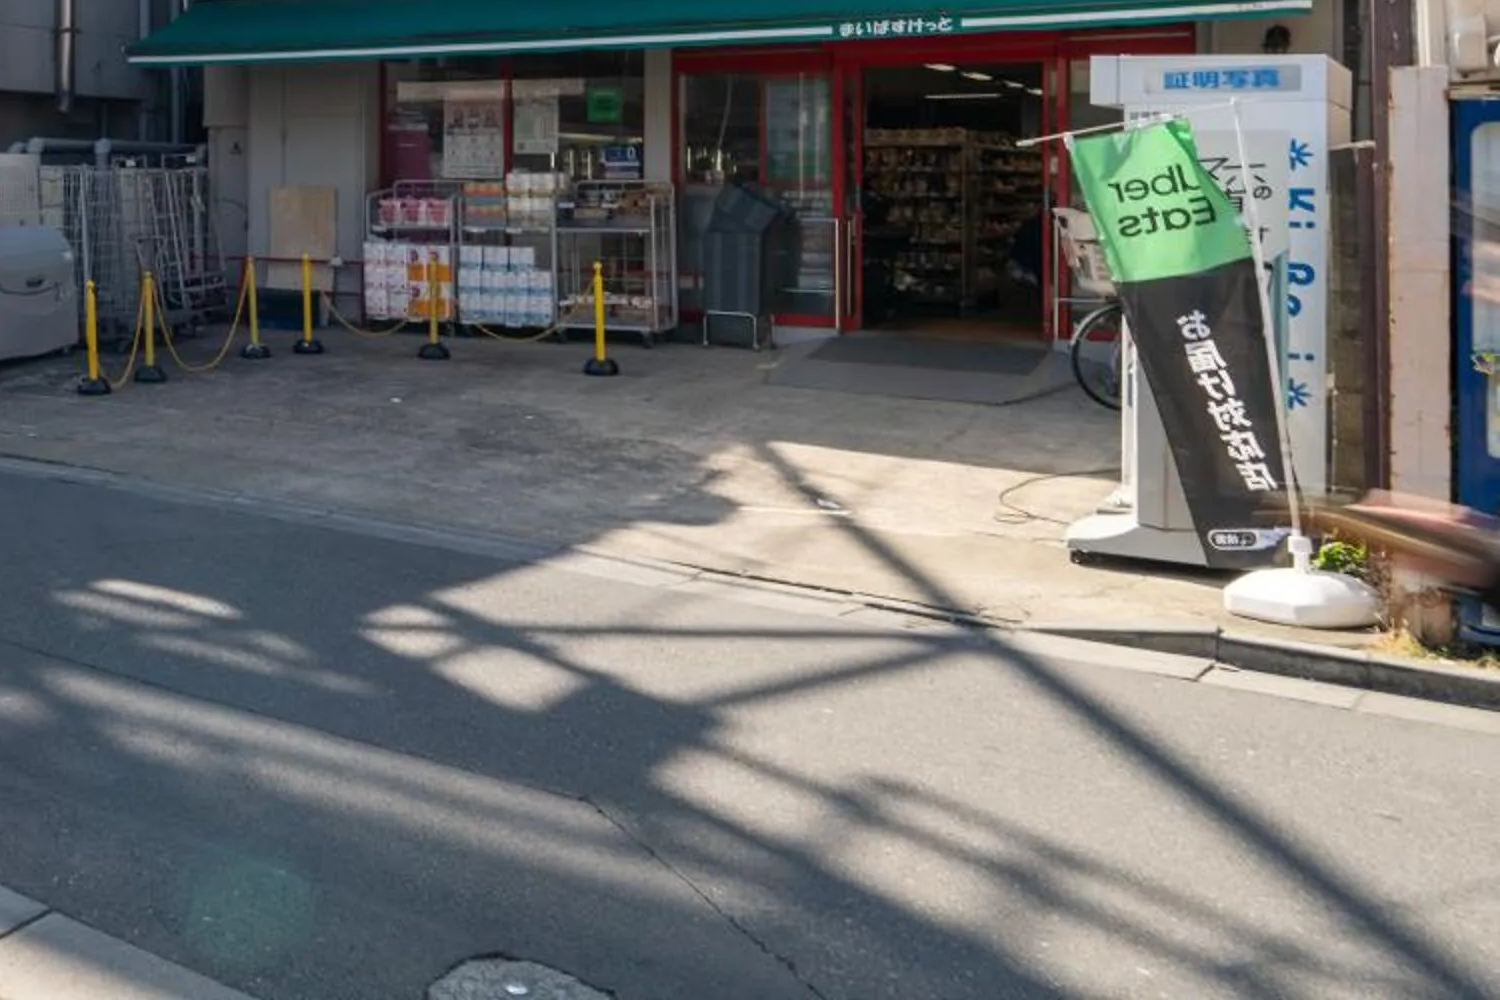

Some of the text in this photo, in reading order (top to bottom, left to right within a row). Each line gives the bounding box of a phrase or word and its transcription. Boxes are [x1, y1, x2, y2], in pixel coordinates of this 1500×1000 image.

[838, 16, 954, 38] まいばすけっと
[1163, 68, 1281, 90] 証明写真
